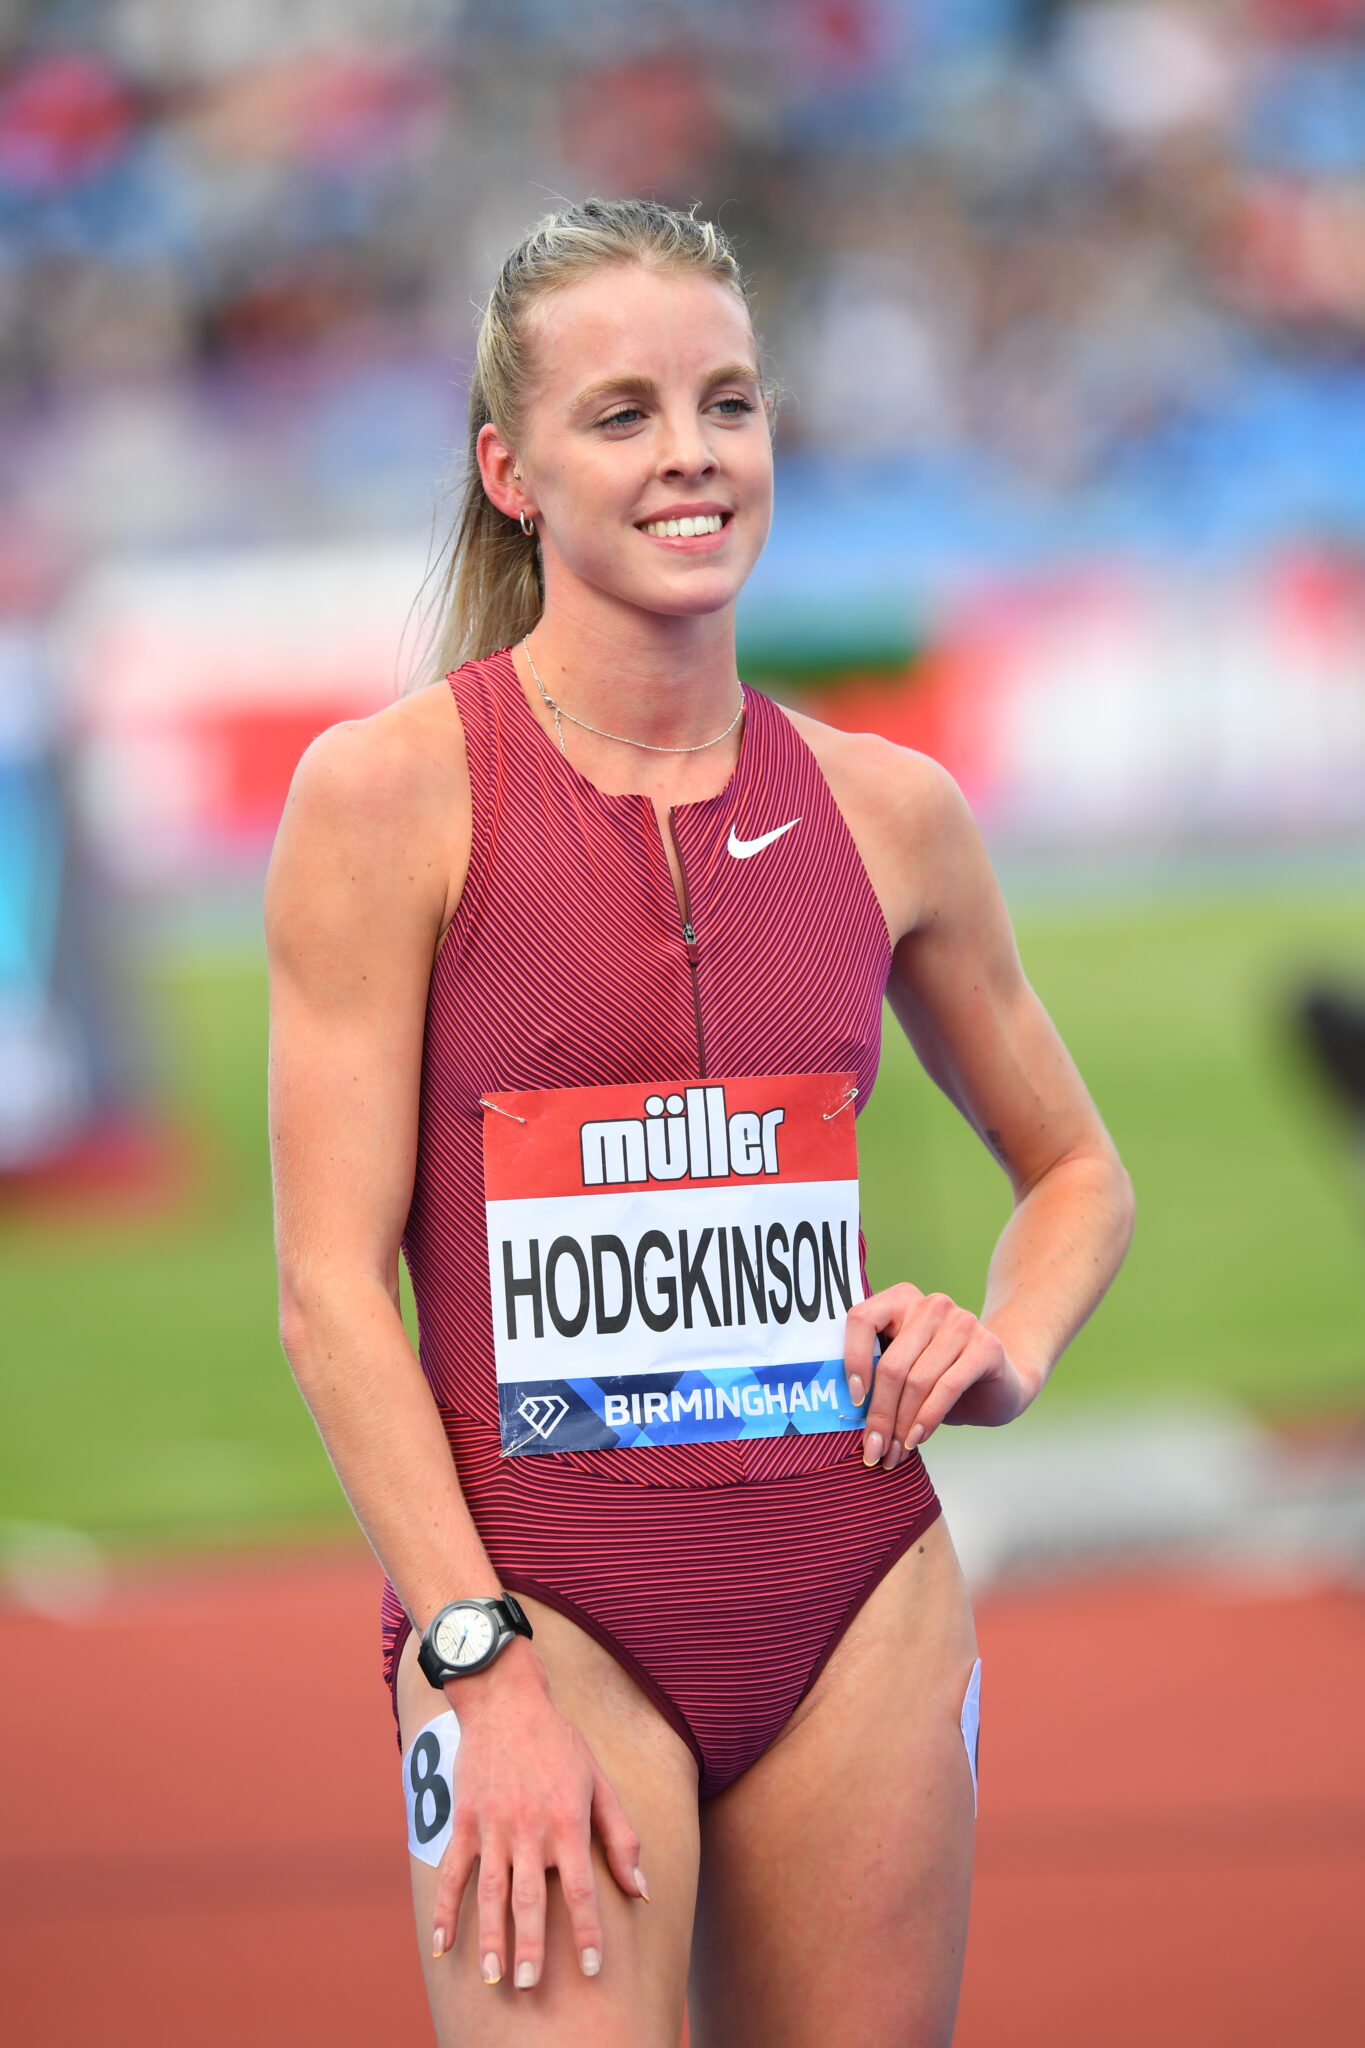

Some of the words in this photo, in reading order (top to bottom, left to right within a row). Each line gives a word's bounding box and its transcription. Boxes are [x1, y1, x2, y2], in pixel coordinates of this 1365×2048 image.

[580, 1085, 785, 1187] müller
[502, 1220, 853, 1341] HODGKINSON
[604, 1379, 839, 1427] BIRMINGHAM
[410, 1731, 451, 1845] 8
